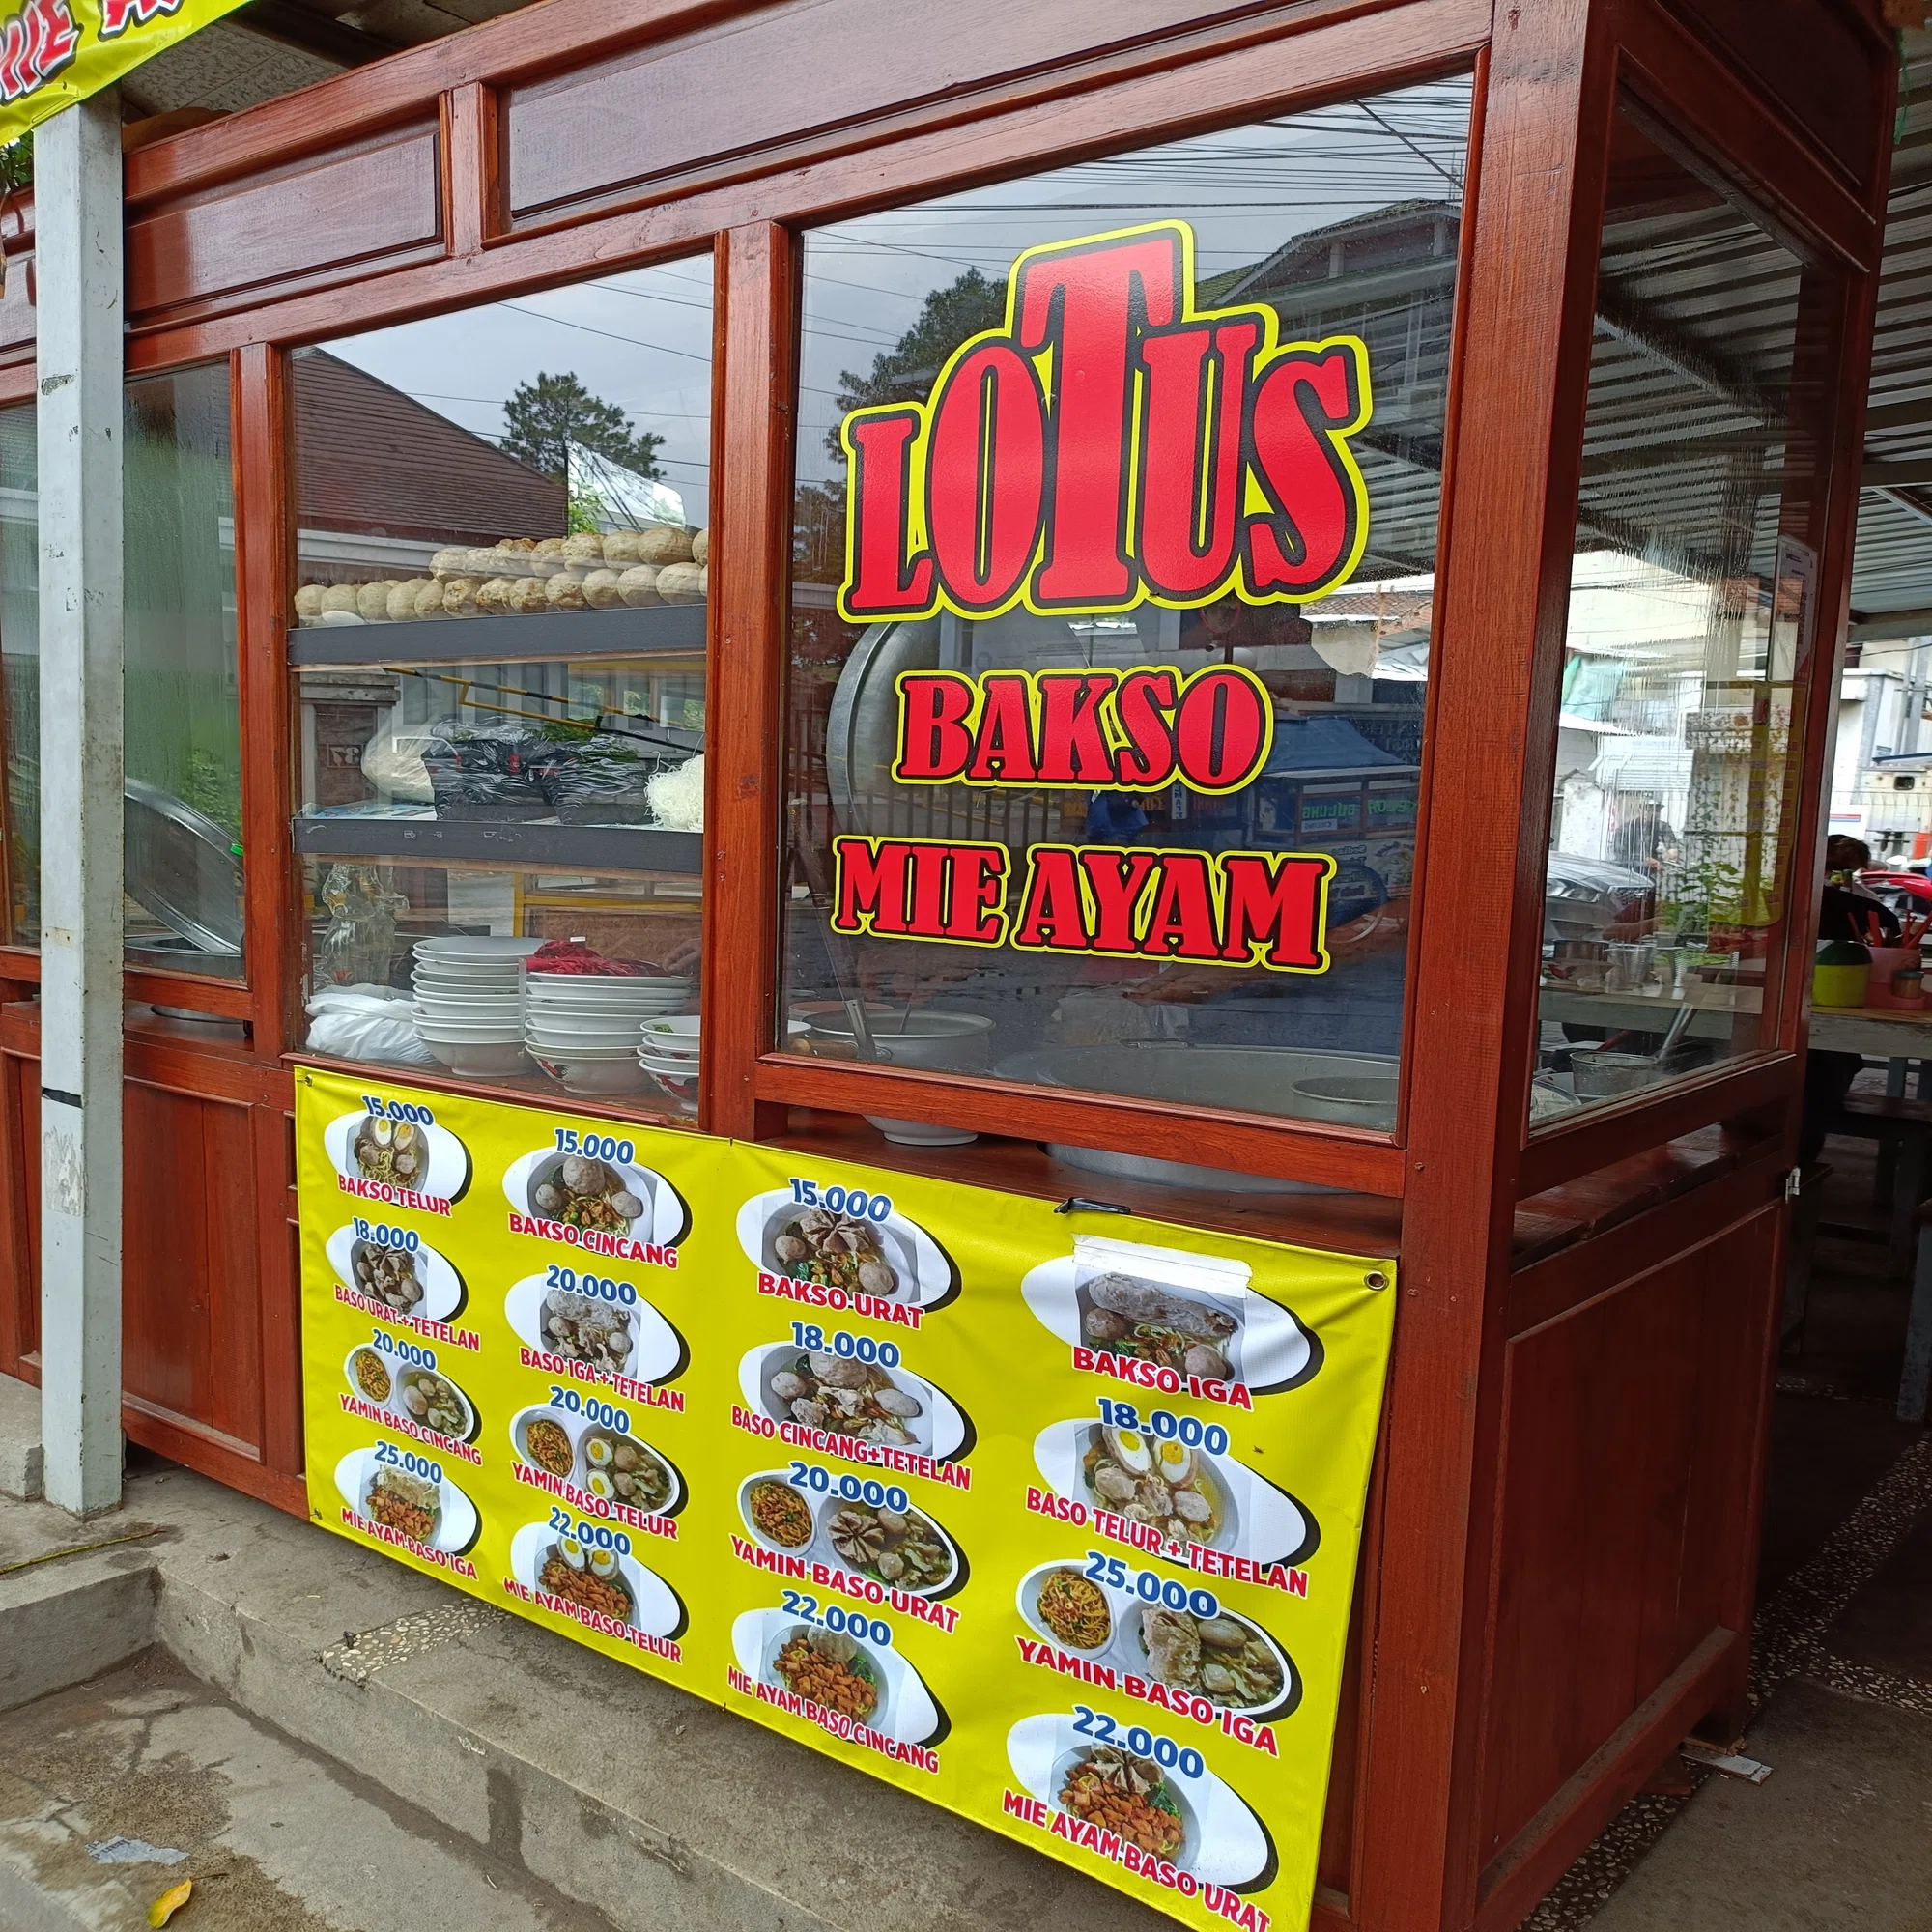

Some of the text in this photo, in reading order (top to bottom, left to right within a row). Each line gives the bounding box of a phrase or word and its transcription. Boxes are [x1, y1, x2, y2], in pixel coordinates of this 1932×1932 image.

[846, 228, 1358, 615] LOTUS
[896, 672, 1265, 786] BAKSO
[836, 840, 1330, 968] MIE AYAM
[362, 1096, 434, 1125] 15.000
[554, 1128, 634, 1164] 15.000
[339, 1174, 450, 1215] BAKSO TELUR
[790, 1179, 891, 1222] 15.000
[354, 1218, 418, 1252] 18.000
[509, 1214, 677, 1268] BAKSO CINCANG
[547, 1265, 637, 1305] 20.000
[759, 1273, 923, 1328] BAKSO URAT
[335, 1285, 365, 1310] BASO
[367, 1298, 397, 1323] URAT
[412, 1317, 479, 1350] TETELAN
[791, 1321, 899, 1368] 18.000
[373, 1330, 436, 1371] 20.000
[520, 1349, 564, 1373] BASO
[569, 1360, 596, 1382] IGA
[613, 1373, 684, 1411] TETELAN
[1073, 1346, 1251, 1409] BAKSO IGA
[339, 1394, 483, 1465] YAMIN BASO CINCANG
[550, 1386, 629, 1434] 20.000
[732, 1406, 775, 1437] BASO
[1098, 1398, 1228, 1456] 18.000
[375, 1441, 442, 1484] 25.000
[789, 1462, 908, 1512] 20.000
[512, 1462, 677, 1539] YAMIN BASO TELUR
[342, 1508, 477, 1579] MIE AYAM BASO IGA
[549, 1507, 630, 1556] 22.000
[1027, 1488, 1087, 1526] BASO
[1093, 1508, 1162, 1555] TELUR
[1188, 1543, 1307, 1597] TETELAN
[730, 1534, 959, 1633] YAMIN BASO URAT
[1085, 1551, 1218, 1618] 25.000
[504, 1578, 682, 1662] MIE AYAM BASO TELUR
[781, 1590, 891, 1647] 22.000
[727, 1665, 937, 1773] MIE AYAM BASO CINCANG
[1016, 1637, 1277, 1755] YAMIN BASO IGA
[1072, 1706, 1204, 1779] 22.000
[1004, 1791, 1270, 1932] MIE AYAM BASO URAT
